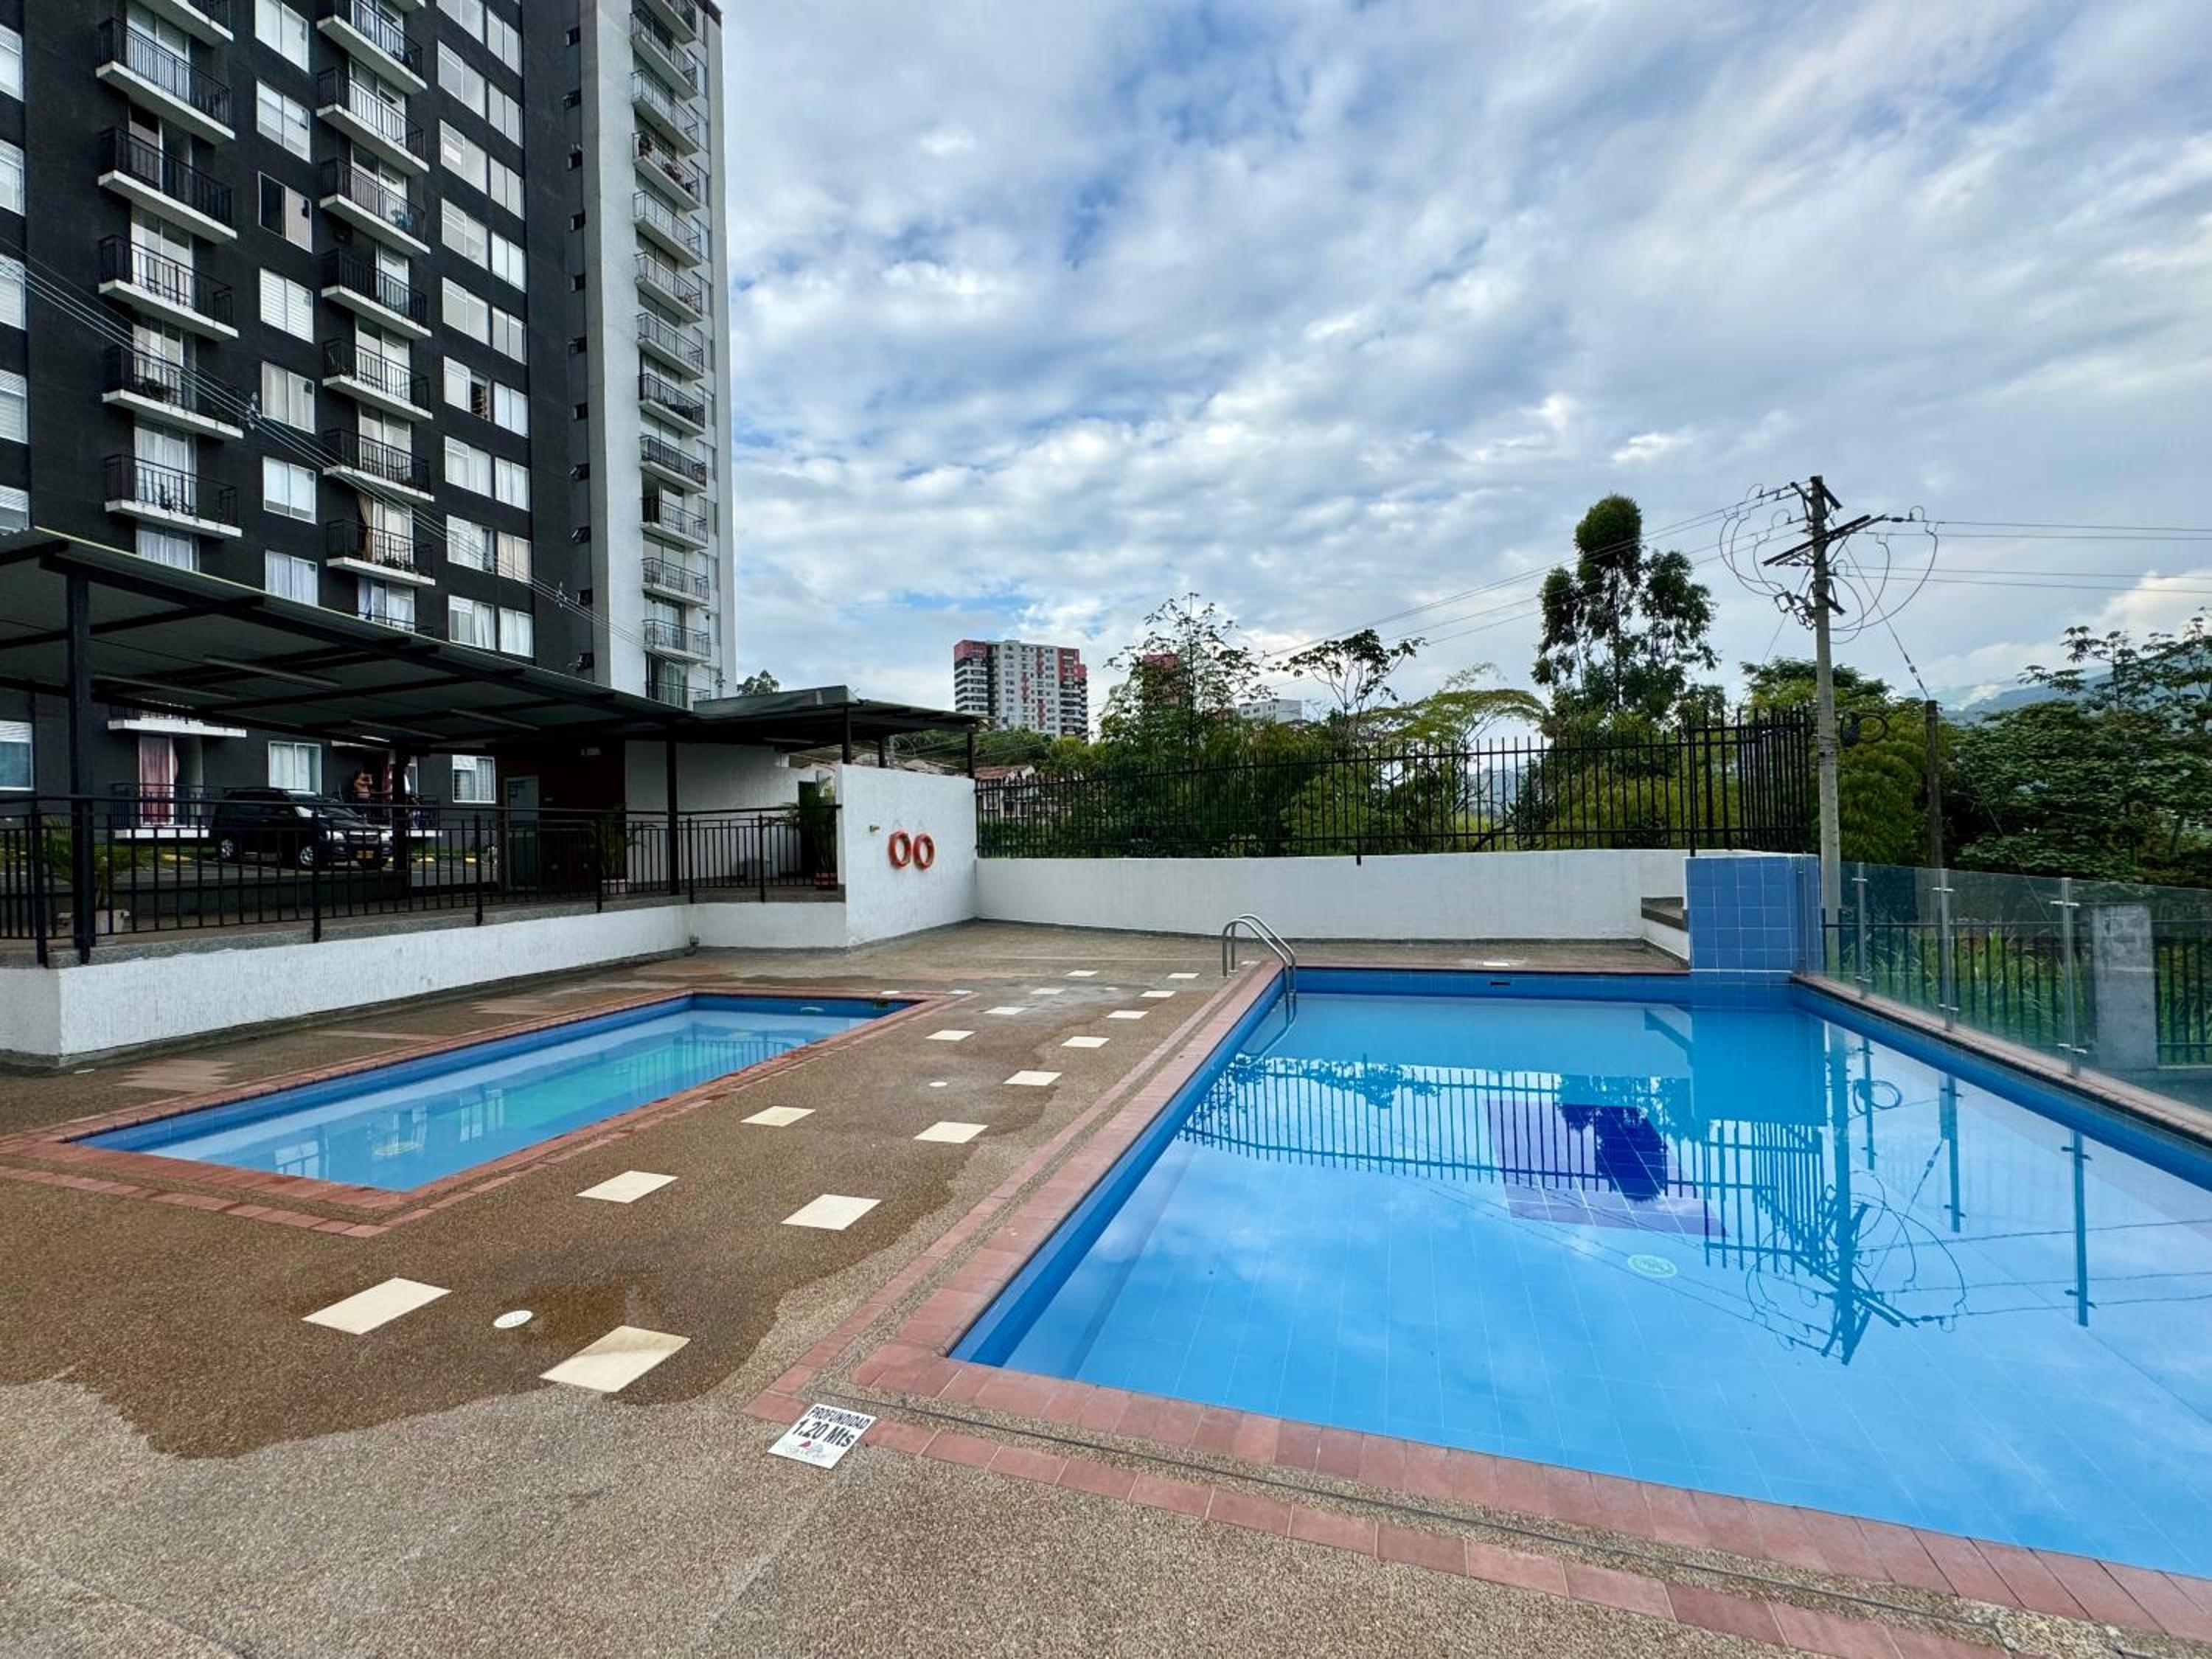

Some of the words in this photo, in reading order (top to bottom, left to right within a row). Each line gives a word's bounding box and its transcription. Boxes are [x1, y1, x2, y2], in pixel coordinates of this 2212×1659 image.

[807, 1406, 871, 1429] PROFUNDIDAD
[793, 1418, 830, 1439] 1.20
[823, 1426, 855, 1447] Mts
